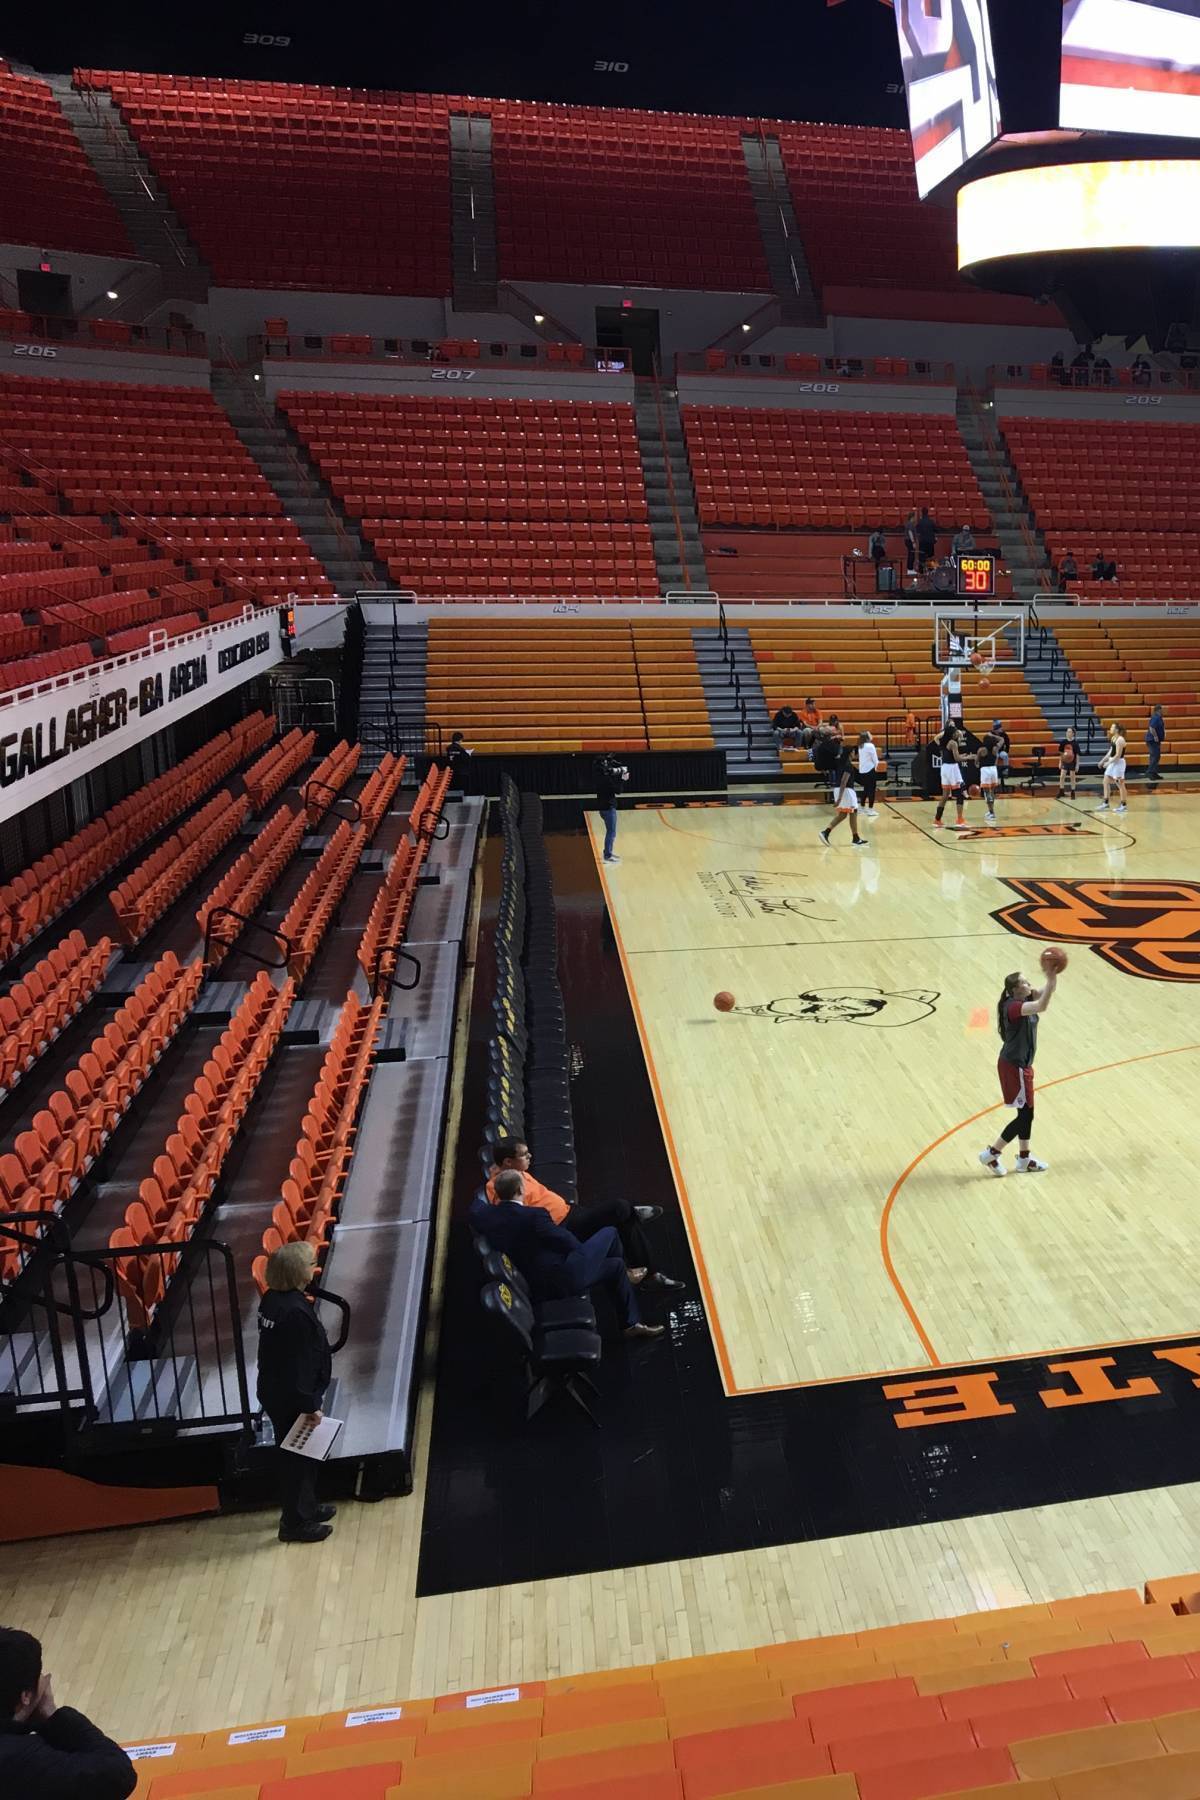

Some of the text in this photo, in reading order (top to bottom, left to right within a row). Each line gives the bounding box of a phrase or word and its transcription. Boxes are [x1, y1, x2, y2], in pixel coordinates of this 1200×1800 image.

[242, 33, 291, 46] 309
[593, 60, 629, 72] 310
[13, 343, 58, 358] 206
[431, 368, 476, 380] 207
[799, 382, 840, 393] 208
[1126, 394, 1162, 405] 209
[960, 559, 991, 571] 60:00
[965, 570, 987, 590] 30
[168, 654, 209, 703] ARENA
